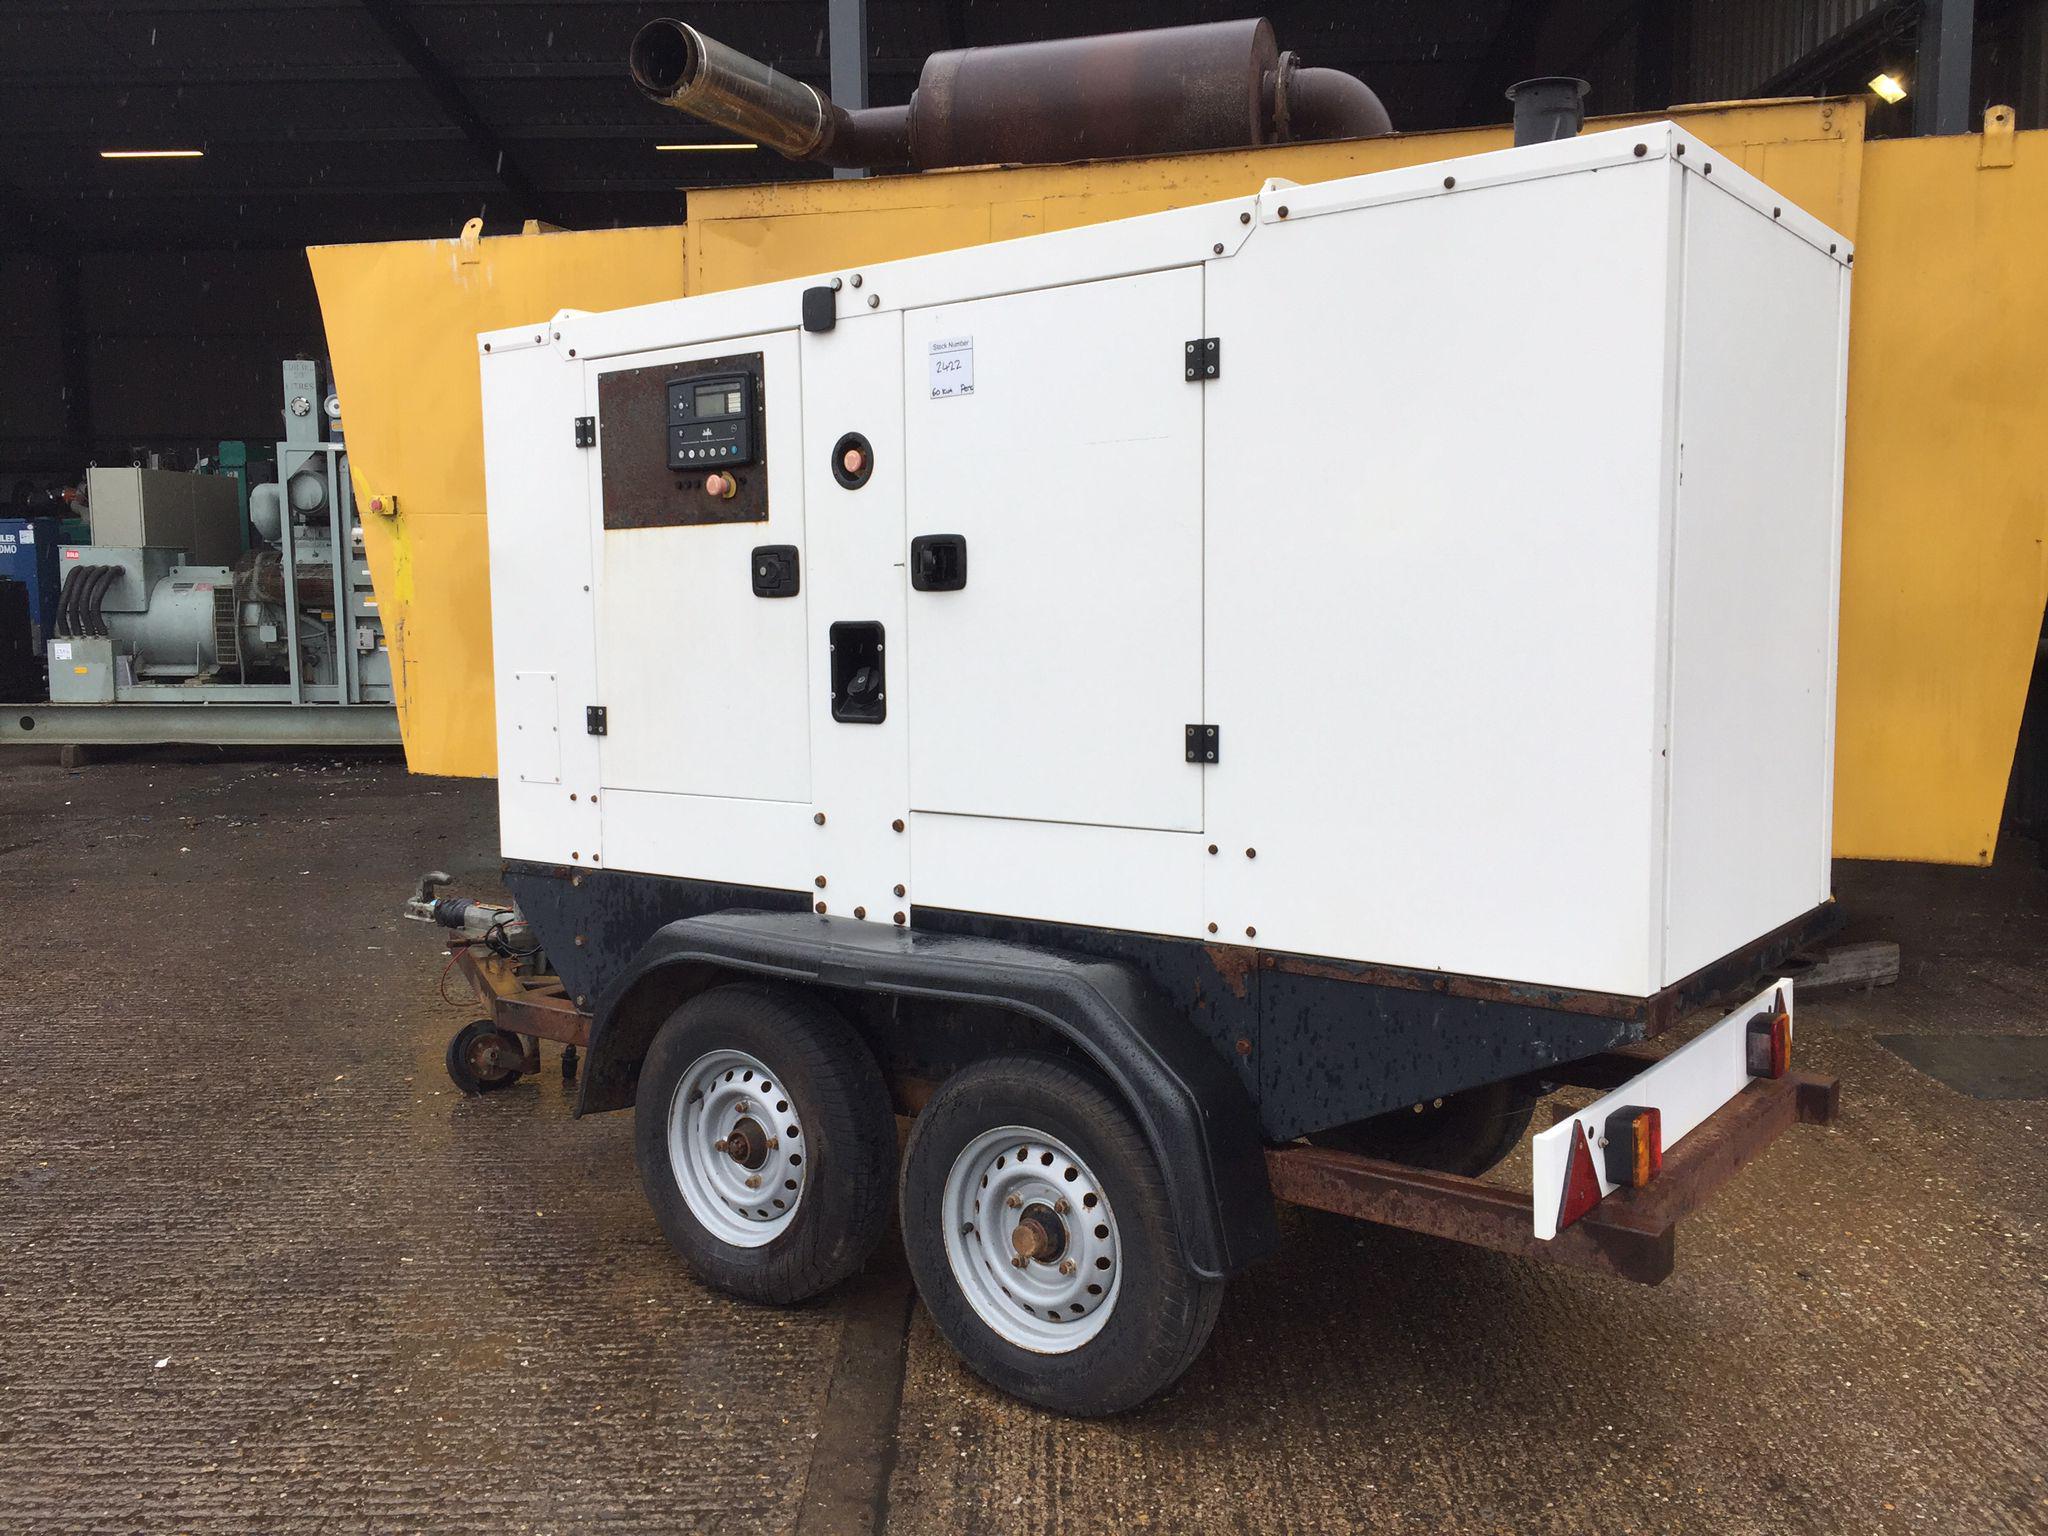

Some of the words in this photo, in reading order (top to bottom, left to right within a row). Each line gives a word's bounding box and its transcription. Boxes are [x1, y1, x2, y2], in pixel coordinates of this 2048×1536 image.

[932, 342, 948, 351] Stock
[949, 340, 969, 348] Number
[936, 359, 962, 374] 2422
[0, 534, 16, 543] LER
